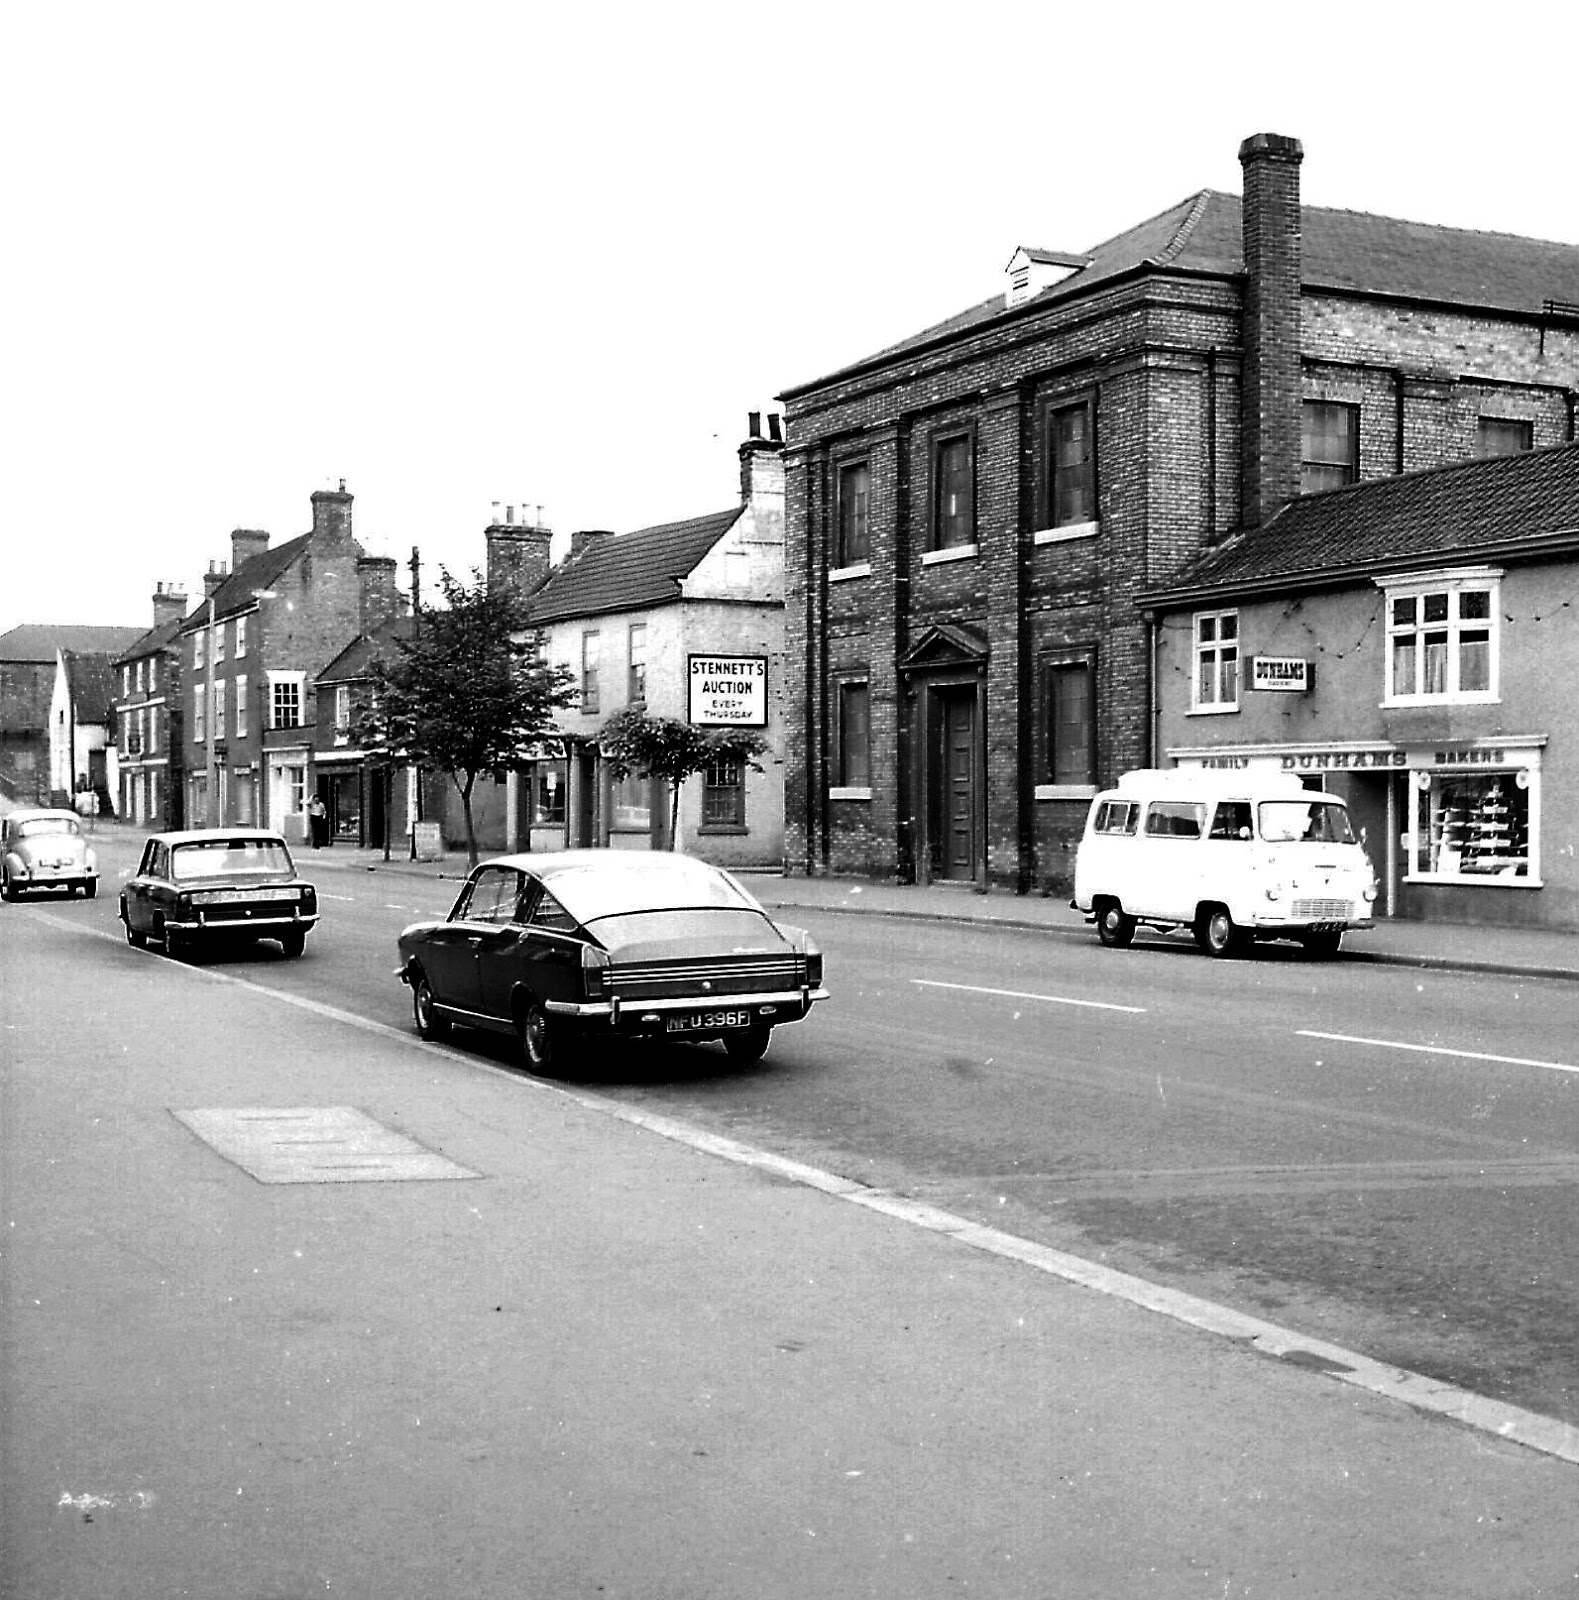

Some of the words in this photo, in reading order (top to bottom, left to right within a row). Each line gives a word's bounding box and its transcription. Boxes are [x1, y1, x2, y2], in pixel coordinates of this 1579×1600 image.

[691, 661, 764, 676] STENNETT'S
[702, 680, 752, 694] AUCTION
[712, 699, 743, 709] EVERY
[703, 710, 753, 719] THURSDAY
[1281, 751, 1407, 769] DUNHAMS
[1435, 751, 1504, 764] BAKERS
